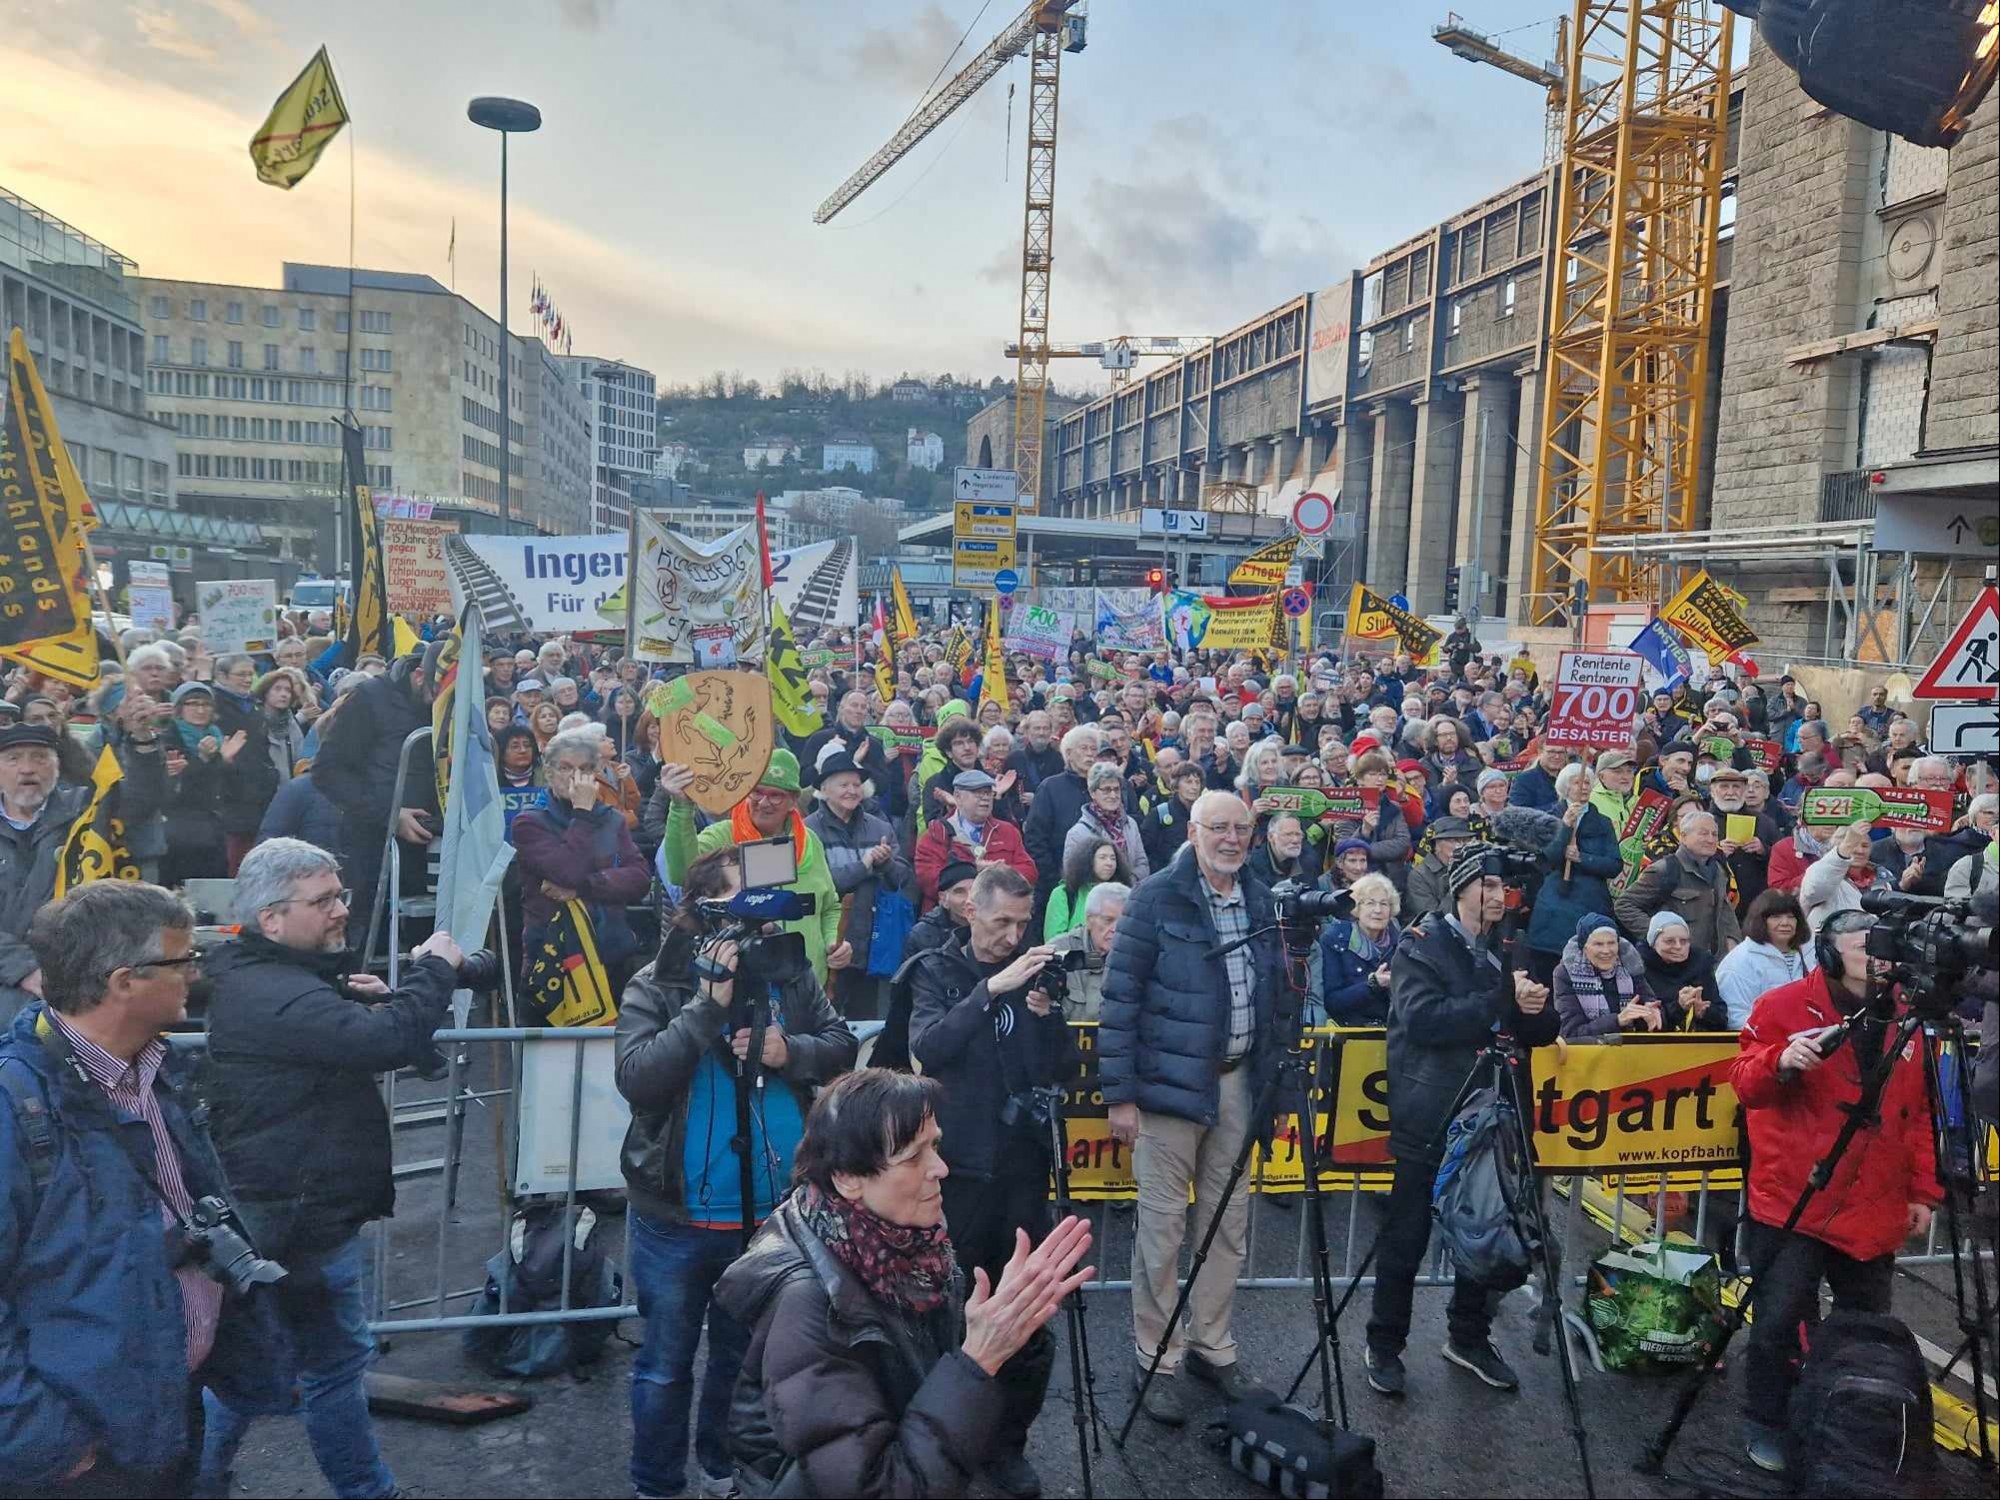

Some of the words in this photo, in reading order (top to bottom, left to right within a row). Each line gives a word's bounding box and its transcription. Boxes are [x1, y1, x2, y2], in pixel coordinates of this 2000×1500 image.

[547, 592, 585, 612] Für
[1028, 606, 1058, 627] 700
[1572, 655, 1632, 671] Renitente
[1570, 669, 1629, 685] Rentnerin
[1557, 685, 1636, 720] 700
[1548, 727, 1631, 743] DESASTER
[1885, 790, 1903, 799] weg
[1907, 792, 1926, 800] mit
[1887, 810, 1903, 819] der
[1906, 812, 1944, 826] Flasche
[1618, 1144, 1736, 1162] www.kopfbahn
